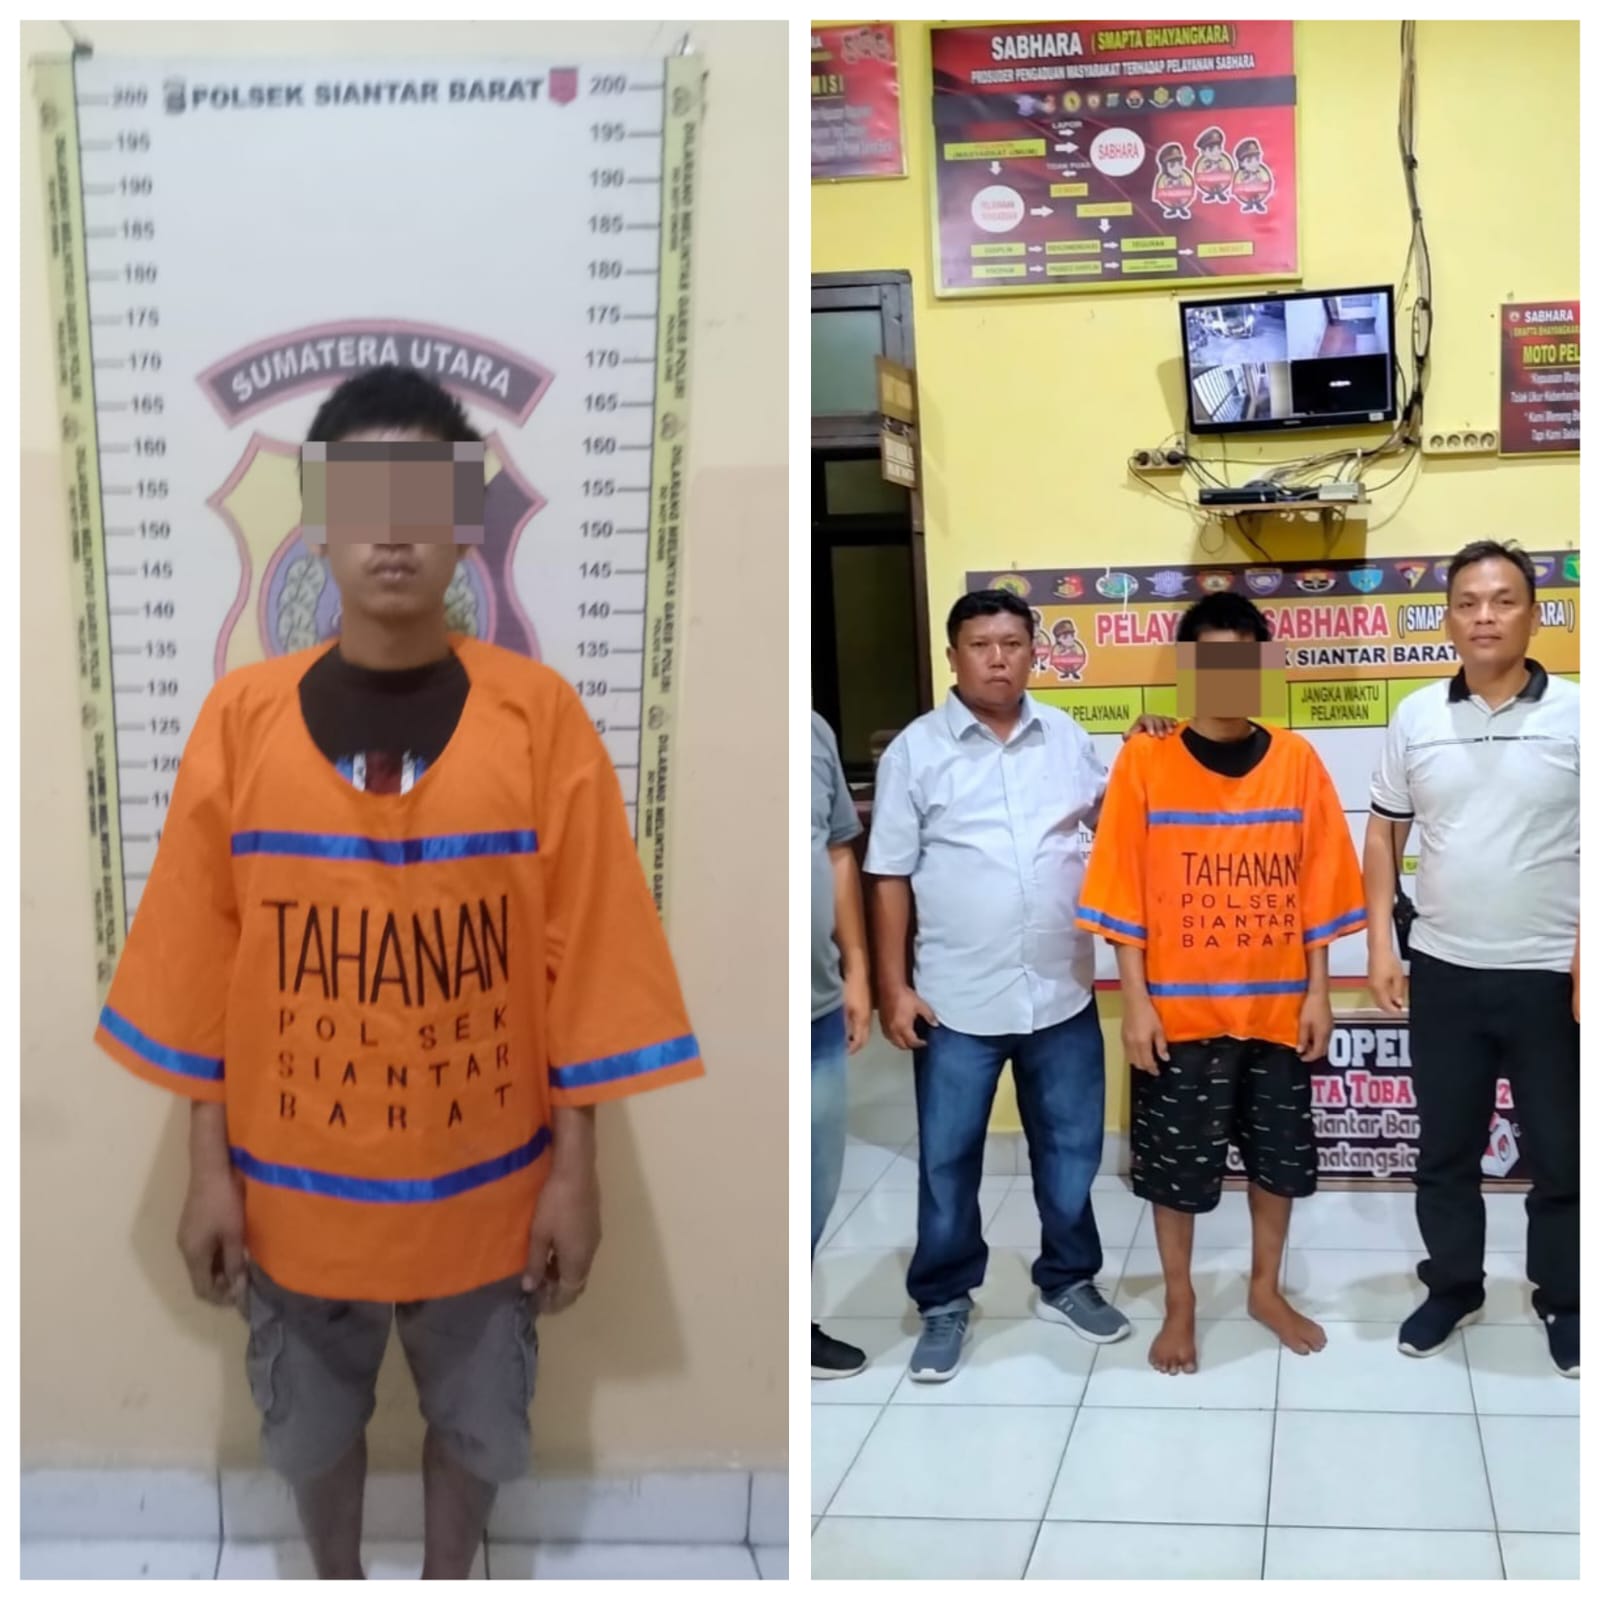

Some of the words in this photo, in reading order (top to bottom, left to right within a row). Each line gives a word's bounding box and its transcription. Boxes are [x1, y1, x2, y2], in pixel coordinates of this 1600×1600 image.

[991, 32, 1084, 61] SABHARA
[1216, 53, 1256, 70] SABHARA
[192, 84, 304, 110] POLSEK
[314, 81, 439, 107] SIANTAR
[450, 78, 544, 103] BARAT
[590, 74, 626, 96] 200
[117, 131, 150, 152] 195
[590, 121, 625, 143] 195
[1098, 143, 1140, 160] SABHARA
[118, 175, 153, 196] 190
[589, 168, 625, 189] 190
[121, 219, 155, 240] 185
[588, 214, 623, 235] 185
[124, 263, 158, 284] 180
[587, 260, 622, 280] 180
[126, 308, 159, 328] 175
[586, 305, 620, 324] 175
[1524, 309, 1574, 323] SABHARA
[129, 353, 161, 371] 170
[585, 349, 619, 368] 170
[1523, 345, 1557, 364] MOTO
[231, 335, 399, 402] SUMATERA
[410, 340, 511, 399] UTARA
[131, 396, 164, 414] 165
[583, 393, 618, 412] 165
[133, 438, 166, 456] 160
[582, 437, 616, 456] 160
[137, 479, 168, 498] 155
[581, 479, 615, 498] 155
[139, 520, 171, 540] 150
[579, 520, 613, 539] 150
[141, 561, 173, 579] 145
[578, 561, 612, 579] 145
[143, 601, 174, 620] 140
[577, 601, 610, 620] 140
[1096, 612, 1179, 646] PELAY
[1262, 604, 1390, 640] SABHARA
[1397, 604, 1448, 639] (SMAP
[144, 641, 176, 659] 135
[577, 641, 609, 658] 135
[1297, 647, 1387, 666] SIANTAR
[1393, 645, 1458, 662] BARAT
[146, 680, 178, 697] 130
[576, 681, 607, 697] 130
[1301, 686, 1342, 703] JANGKA
[1343, 685, 1380, 701] WAKTU
[1073, 704, 1130, 721] PELAYANAN
[1311, 703, 1369, 721] PELAYANAN
[148, 719, 180, 736] 125
[151, 756, 180, 772] 120
[153, 793, 170, 808] 11
[1182, 852, 1298, 888] TAHANAN
[1182, 893, 1297, 909] POLSEK
[1182, 914, 1296, 930] SIANTAR
[1182, 931, 1296, 948] BARAT
[261, 894, 508, 1007] TAHANAN
[279, 1006, 507, 1050] POLSEK
[278, 1042, 508, 1088] SIANTAR
[1311, 1077, 1344, 1105] TA
[280, 1082, 511, 1130] BARAT
[1312, 1110, 1381, 1136] iantar
[1384, 1110, 1419, 1136] Bar
